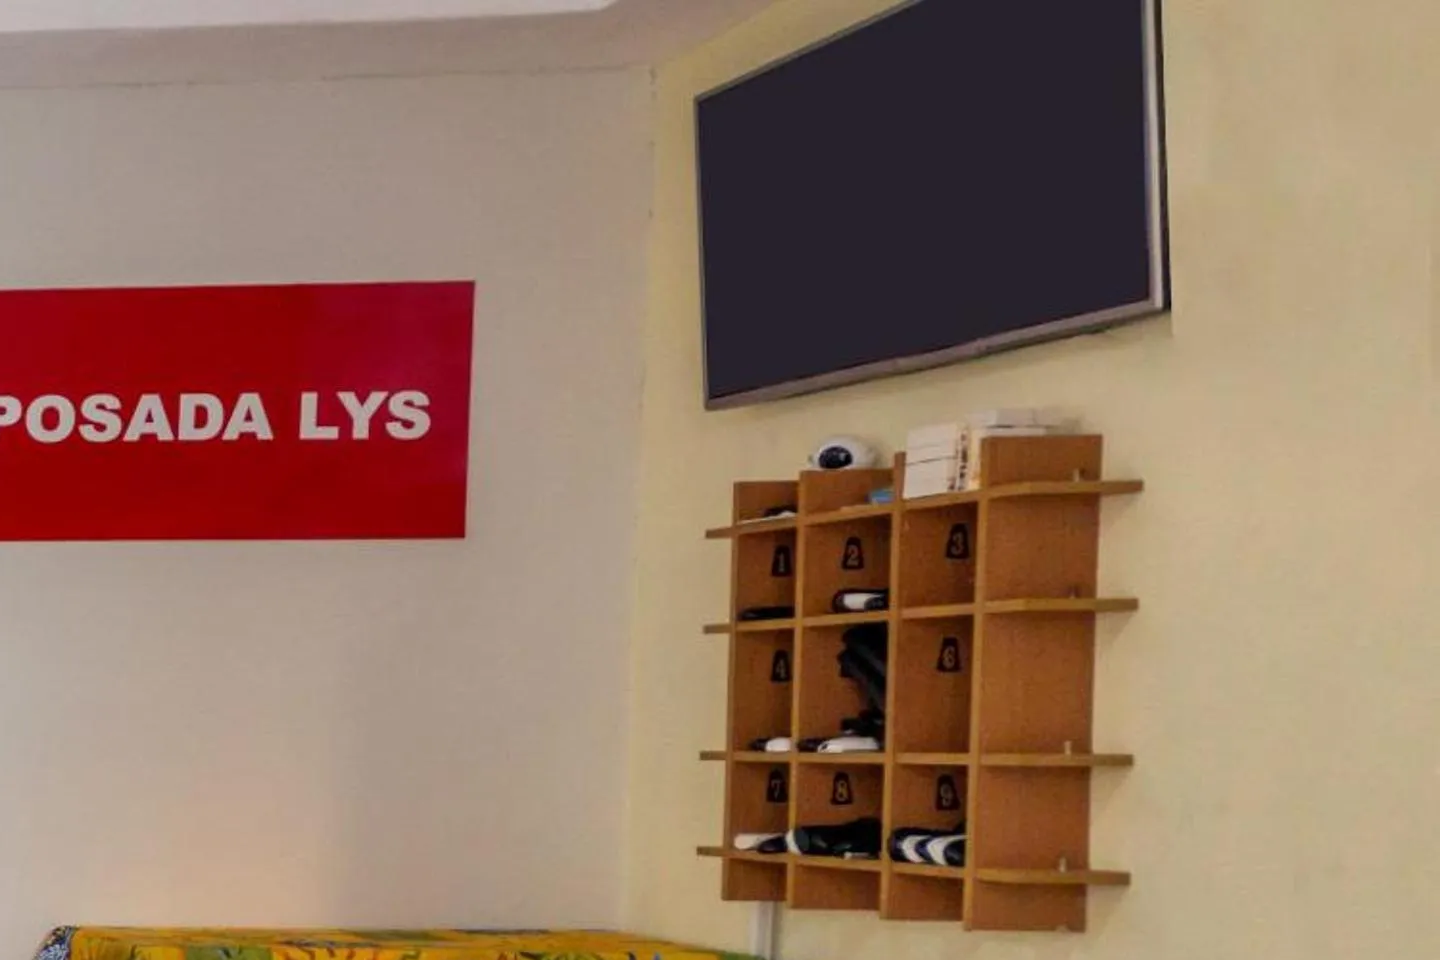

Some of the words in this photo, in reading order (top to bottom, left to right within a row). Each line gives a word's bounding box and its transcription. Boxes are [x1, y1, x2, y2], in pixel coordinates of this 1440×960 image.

[299, 390, 431, 440] LYS
[951, 531, 963, 555] 3
[777, 551, 786, 573] 1
[846, 545, 859, 567] 2
[942, 645, 955, 669] 6
[775, 658, 787, 679] 4
[770, 778, 782, 799] 7
[834, 779, 848, 802] 8
